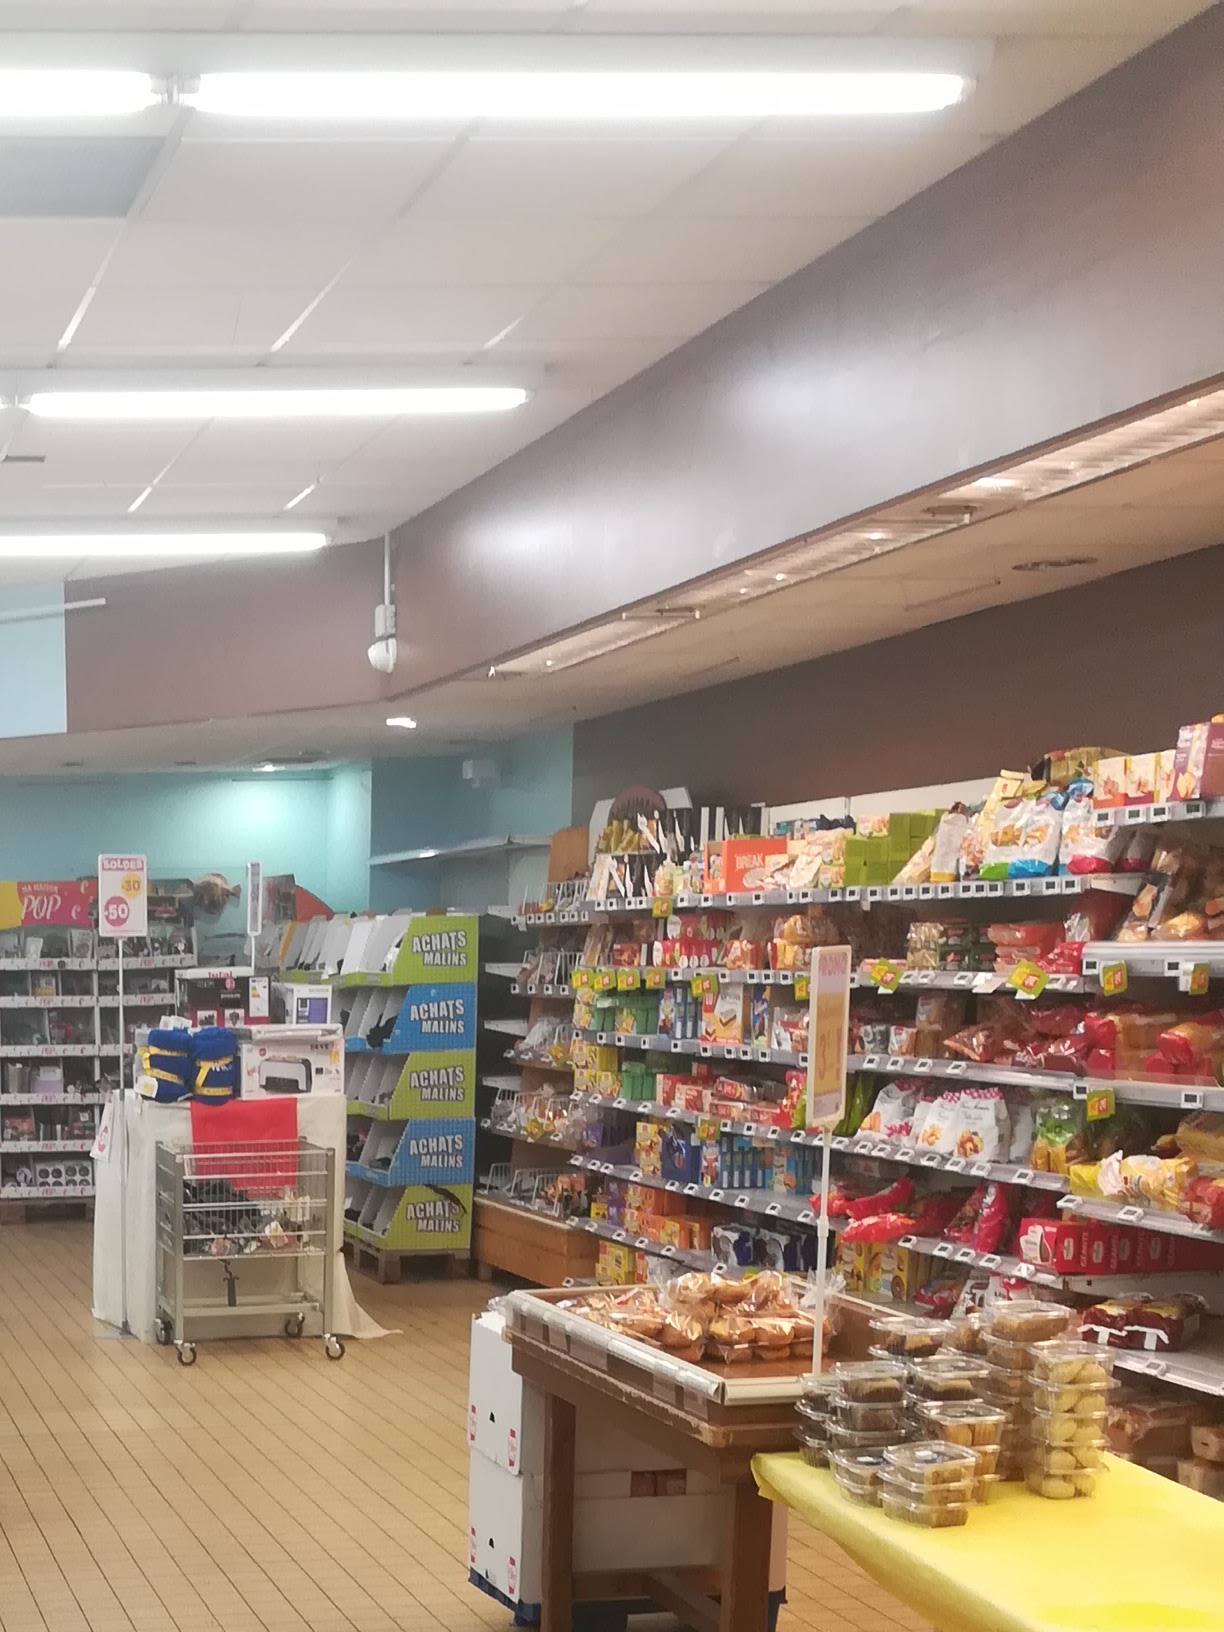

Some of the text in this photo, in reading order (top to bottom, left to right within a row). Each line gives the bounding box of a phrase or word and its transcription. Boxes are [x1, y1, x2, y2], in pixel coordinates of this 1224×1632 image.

[102, 857, 143, 870] SOLDES
[22, 894, 62, 920] POP
[412, 930, 467, 953] ACHATS
[423, 952, 467, 966] MALINS
[410, 999, 464, 1021] ACHATS
[421, 1020, 465, 1033] MALINS
[409, 1067, 464, 1088] ACHATS
[421, 1087, 464, 1101] MALINS
[409, 1134, 463, 1155] ACHATS
[420, 1154, 463, 1168] MALINS
[406, 1199, 460, 1219] ACHATS
[417, 1219, 460, 1232] MALINS
